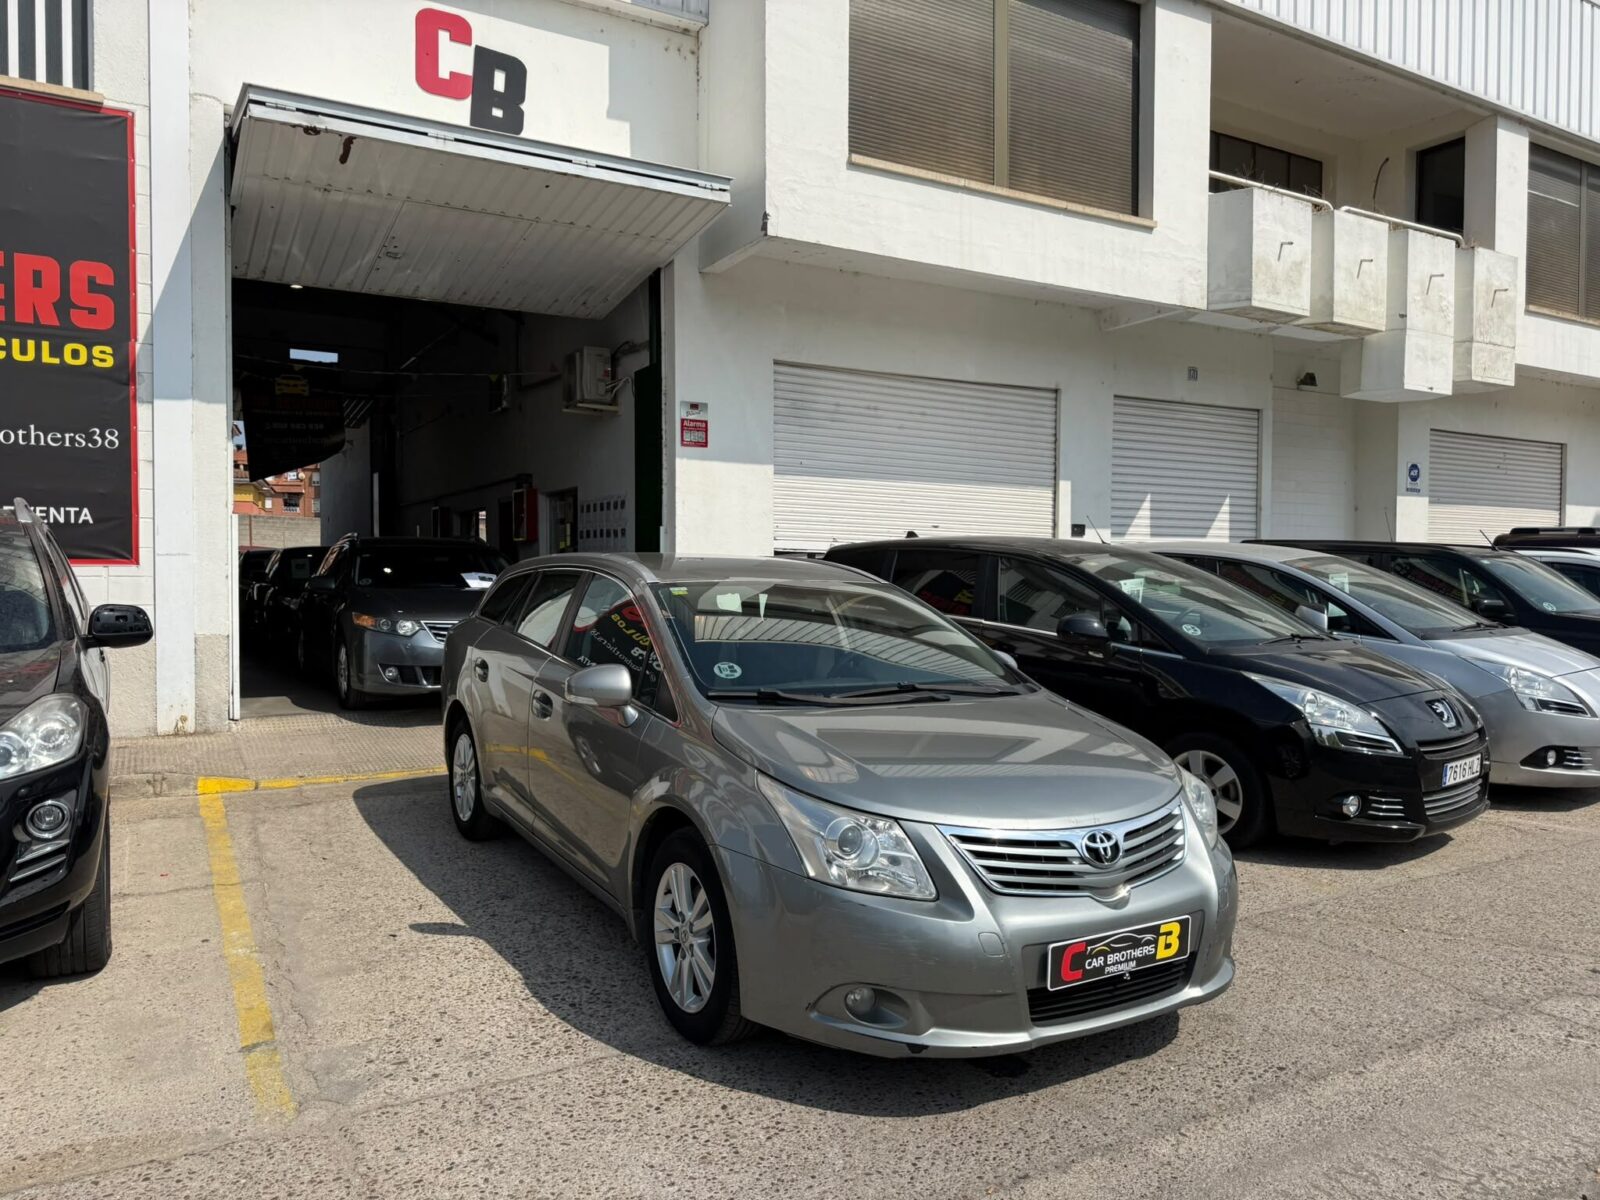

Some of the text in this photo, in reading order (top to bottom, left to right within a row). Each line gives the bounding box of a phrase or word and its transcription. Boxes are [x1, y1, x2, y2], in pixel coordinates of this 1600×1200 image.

[415, 7, 527, 136] CB
[0, 250, 115, 331] RS
[0, 337, 115, 368] ULOS
[0, 424, 119, 449] others38
[30, 506, 94, 524] ENTA
[1448, 762, 1467, 782] 7616
[1156, 921, 1181, 960] B
[1061, 941, 1087, 982] C
[1085, 944, 1155, 970] CAR BROTHERS
[1104, 960, 1137, 974] PREMIUM
